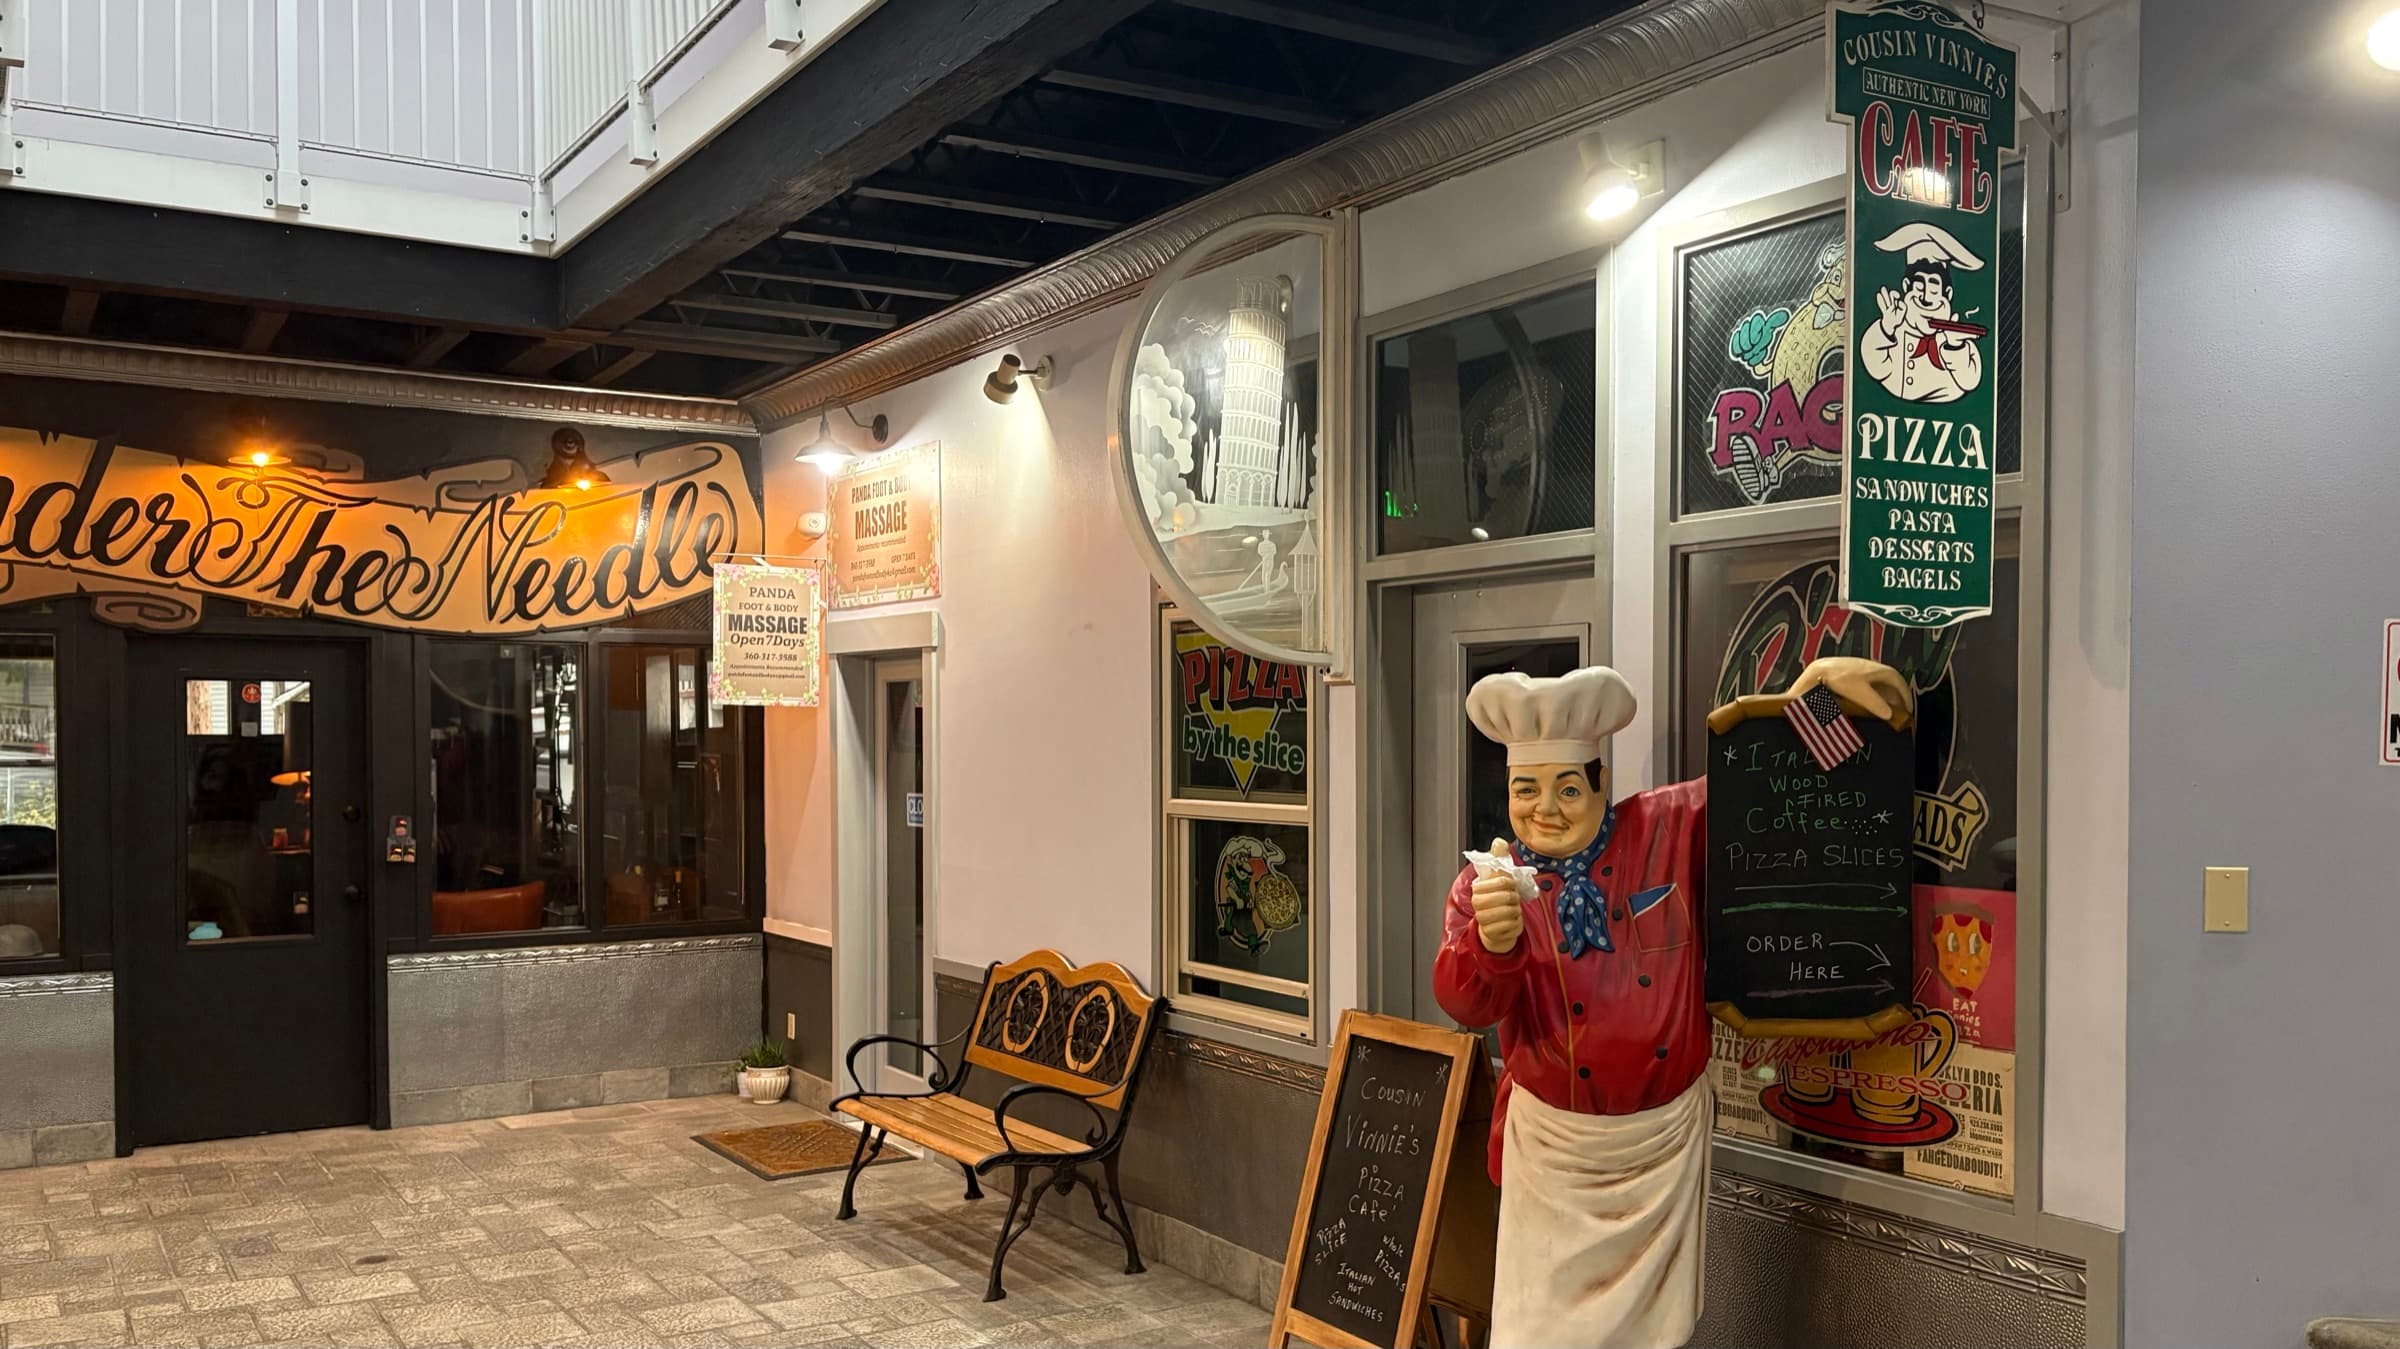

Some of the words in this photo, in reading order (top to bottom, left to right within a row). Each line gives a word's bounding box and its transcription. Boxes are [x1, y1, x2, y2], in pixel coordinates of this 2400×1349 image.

[1843, 29, 1917, 66] COUSIN
[1925, 32, 2009, 100] VINNIES
[1866, 71, 1930, 102] AUTHENTIC
[1932, 84, 1958, 108] NEW
[1960, 90, 1989, 116] YORK
[1859, 100, 1993, 215] CAFE
[1856, 412, 1989, 471] PIZZA
[851, 483, 871, 505] PANDA
[872, 479, 887, 500] FOOT
[888, 480, 894, 495] &
[1855, 476, 1989, 509] SANDWICHES
[855, 500, 908, 540] MASSAGE
[1888, 507, 1957, 535] PASTA
[183, 474, 396, 615] The
[386, 480, 738, 624] Needle
[1868, 536, 1976, 565] DESSERTS
[749, 586, 796, 600] PANDA
[1881, 566, 1962, 592] BAGELS
[738, 601, 764, 611] FOOT
[765, 603, 772, 611] &
[773, 604, 799, 613] BODY
[728, 613, 808, 635] MASSAGE
[1182, 646, 1305, 705] PIZZA
[1183, 715, 1212, 761] by
[1213, 723, 1251, 763] the
[1252, 730, 1305, 775] slice
[1745, 741, 1872, 772] ITALN
[1725, 841, 1809, 872] PIZZA
[1823, 843, 1905, 868] SLICES
[1746, 932, 1823, 953] ORDER
[1789, 961, 1845, 981] HERE
[1952, 997, 1978, 1013] EAT
[1791, 1063, 1969, 1102] ESPRESSO
[1972, 1069, 2003, 1089] BROS.
[1337, 1262, 1377, 1287] ITALIAN
[1347, 1281, 1364, 1296] HOT
[1327, 1290, 1384, 1322] SANDWICHES
